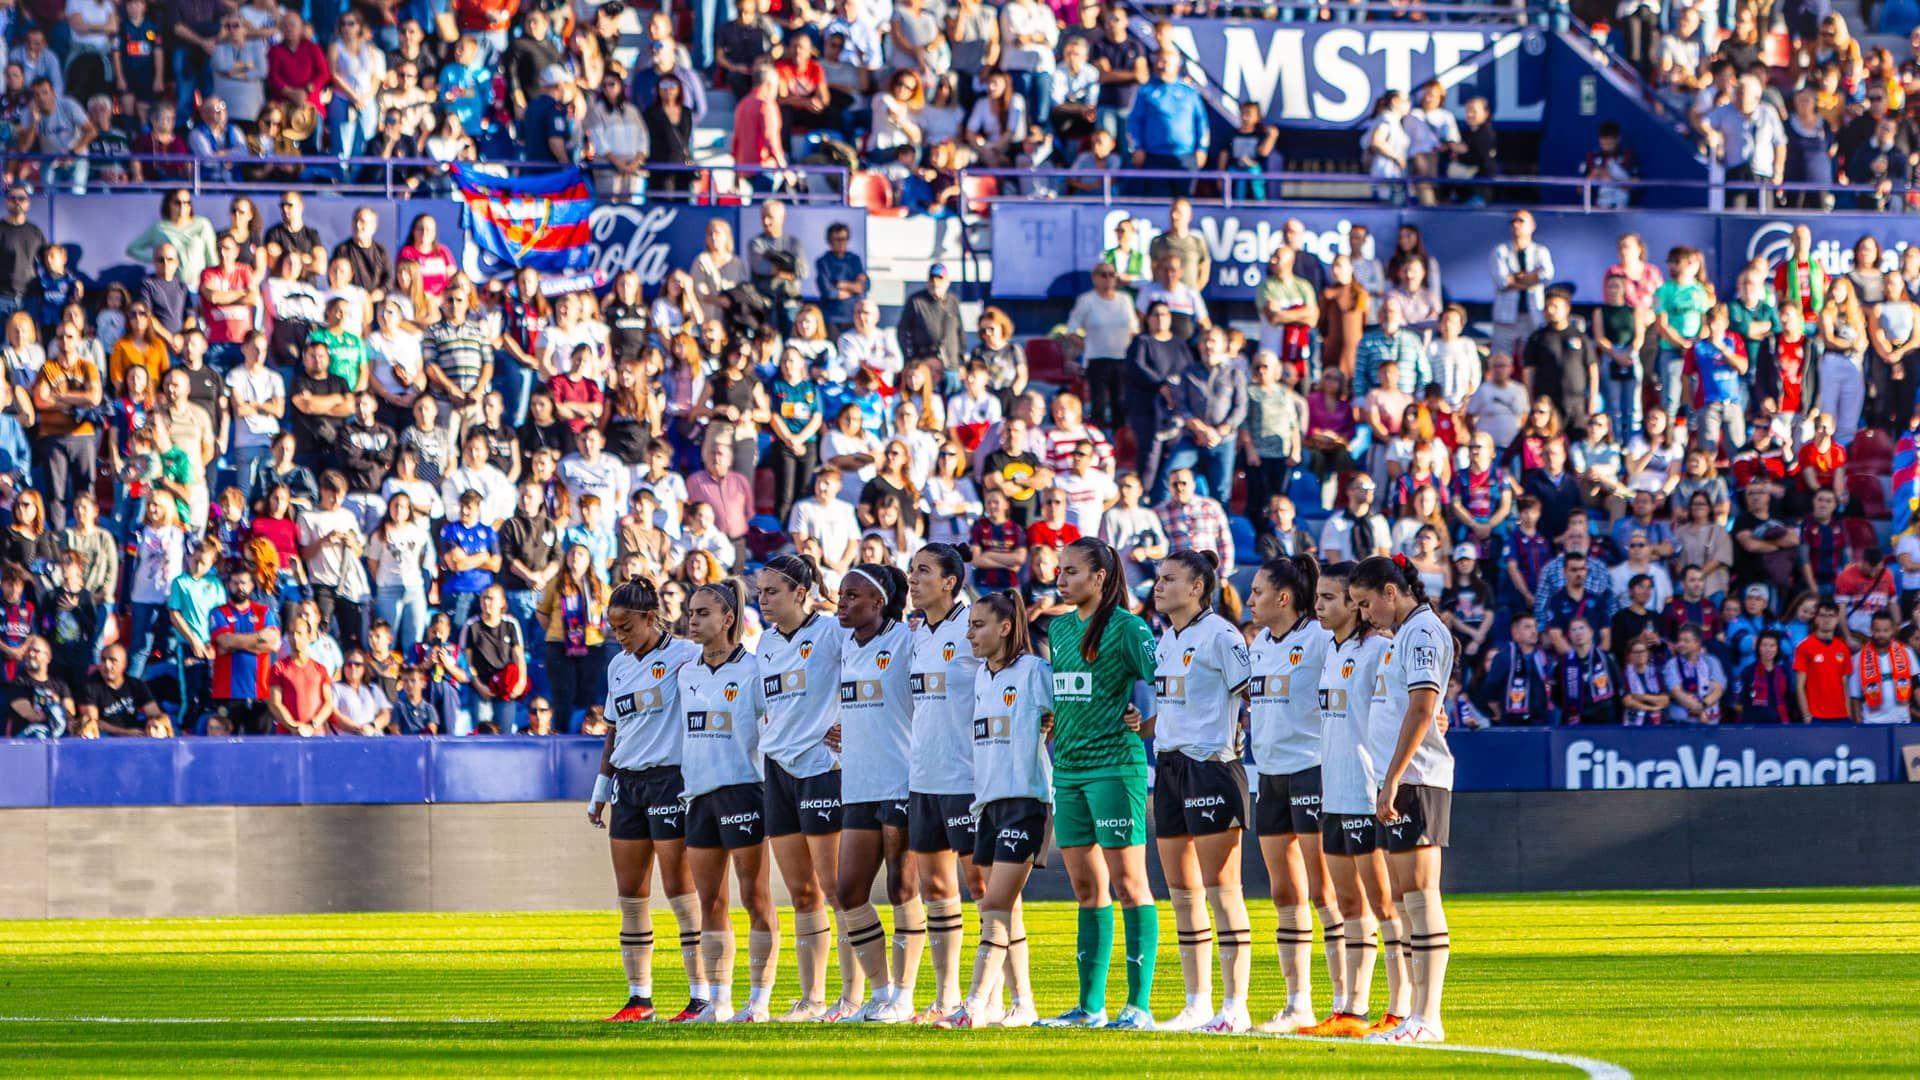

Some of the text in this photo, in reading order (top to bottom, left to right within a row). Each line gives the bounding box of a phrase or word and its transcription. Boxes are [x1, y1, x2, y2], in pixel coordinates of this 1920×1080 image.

[765, 678, 779, 695] TM
[1250, 680, 1262, 694] TM
[841, 687, 854, 700] TM
[616, 697, 633, 715] TM
[688, 714, 704, 728] TM
[800, 799, 841, 809] SKODA
[1184, 795, 1225, 808] SKODA
[1290, 796, 1323, 806] SKOD
[720, 811, 760, 825] SKODA
[947, 815, 977, 827] SKOD
[1095, 818, 1135, 828] SKODA
